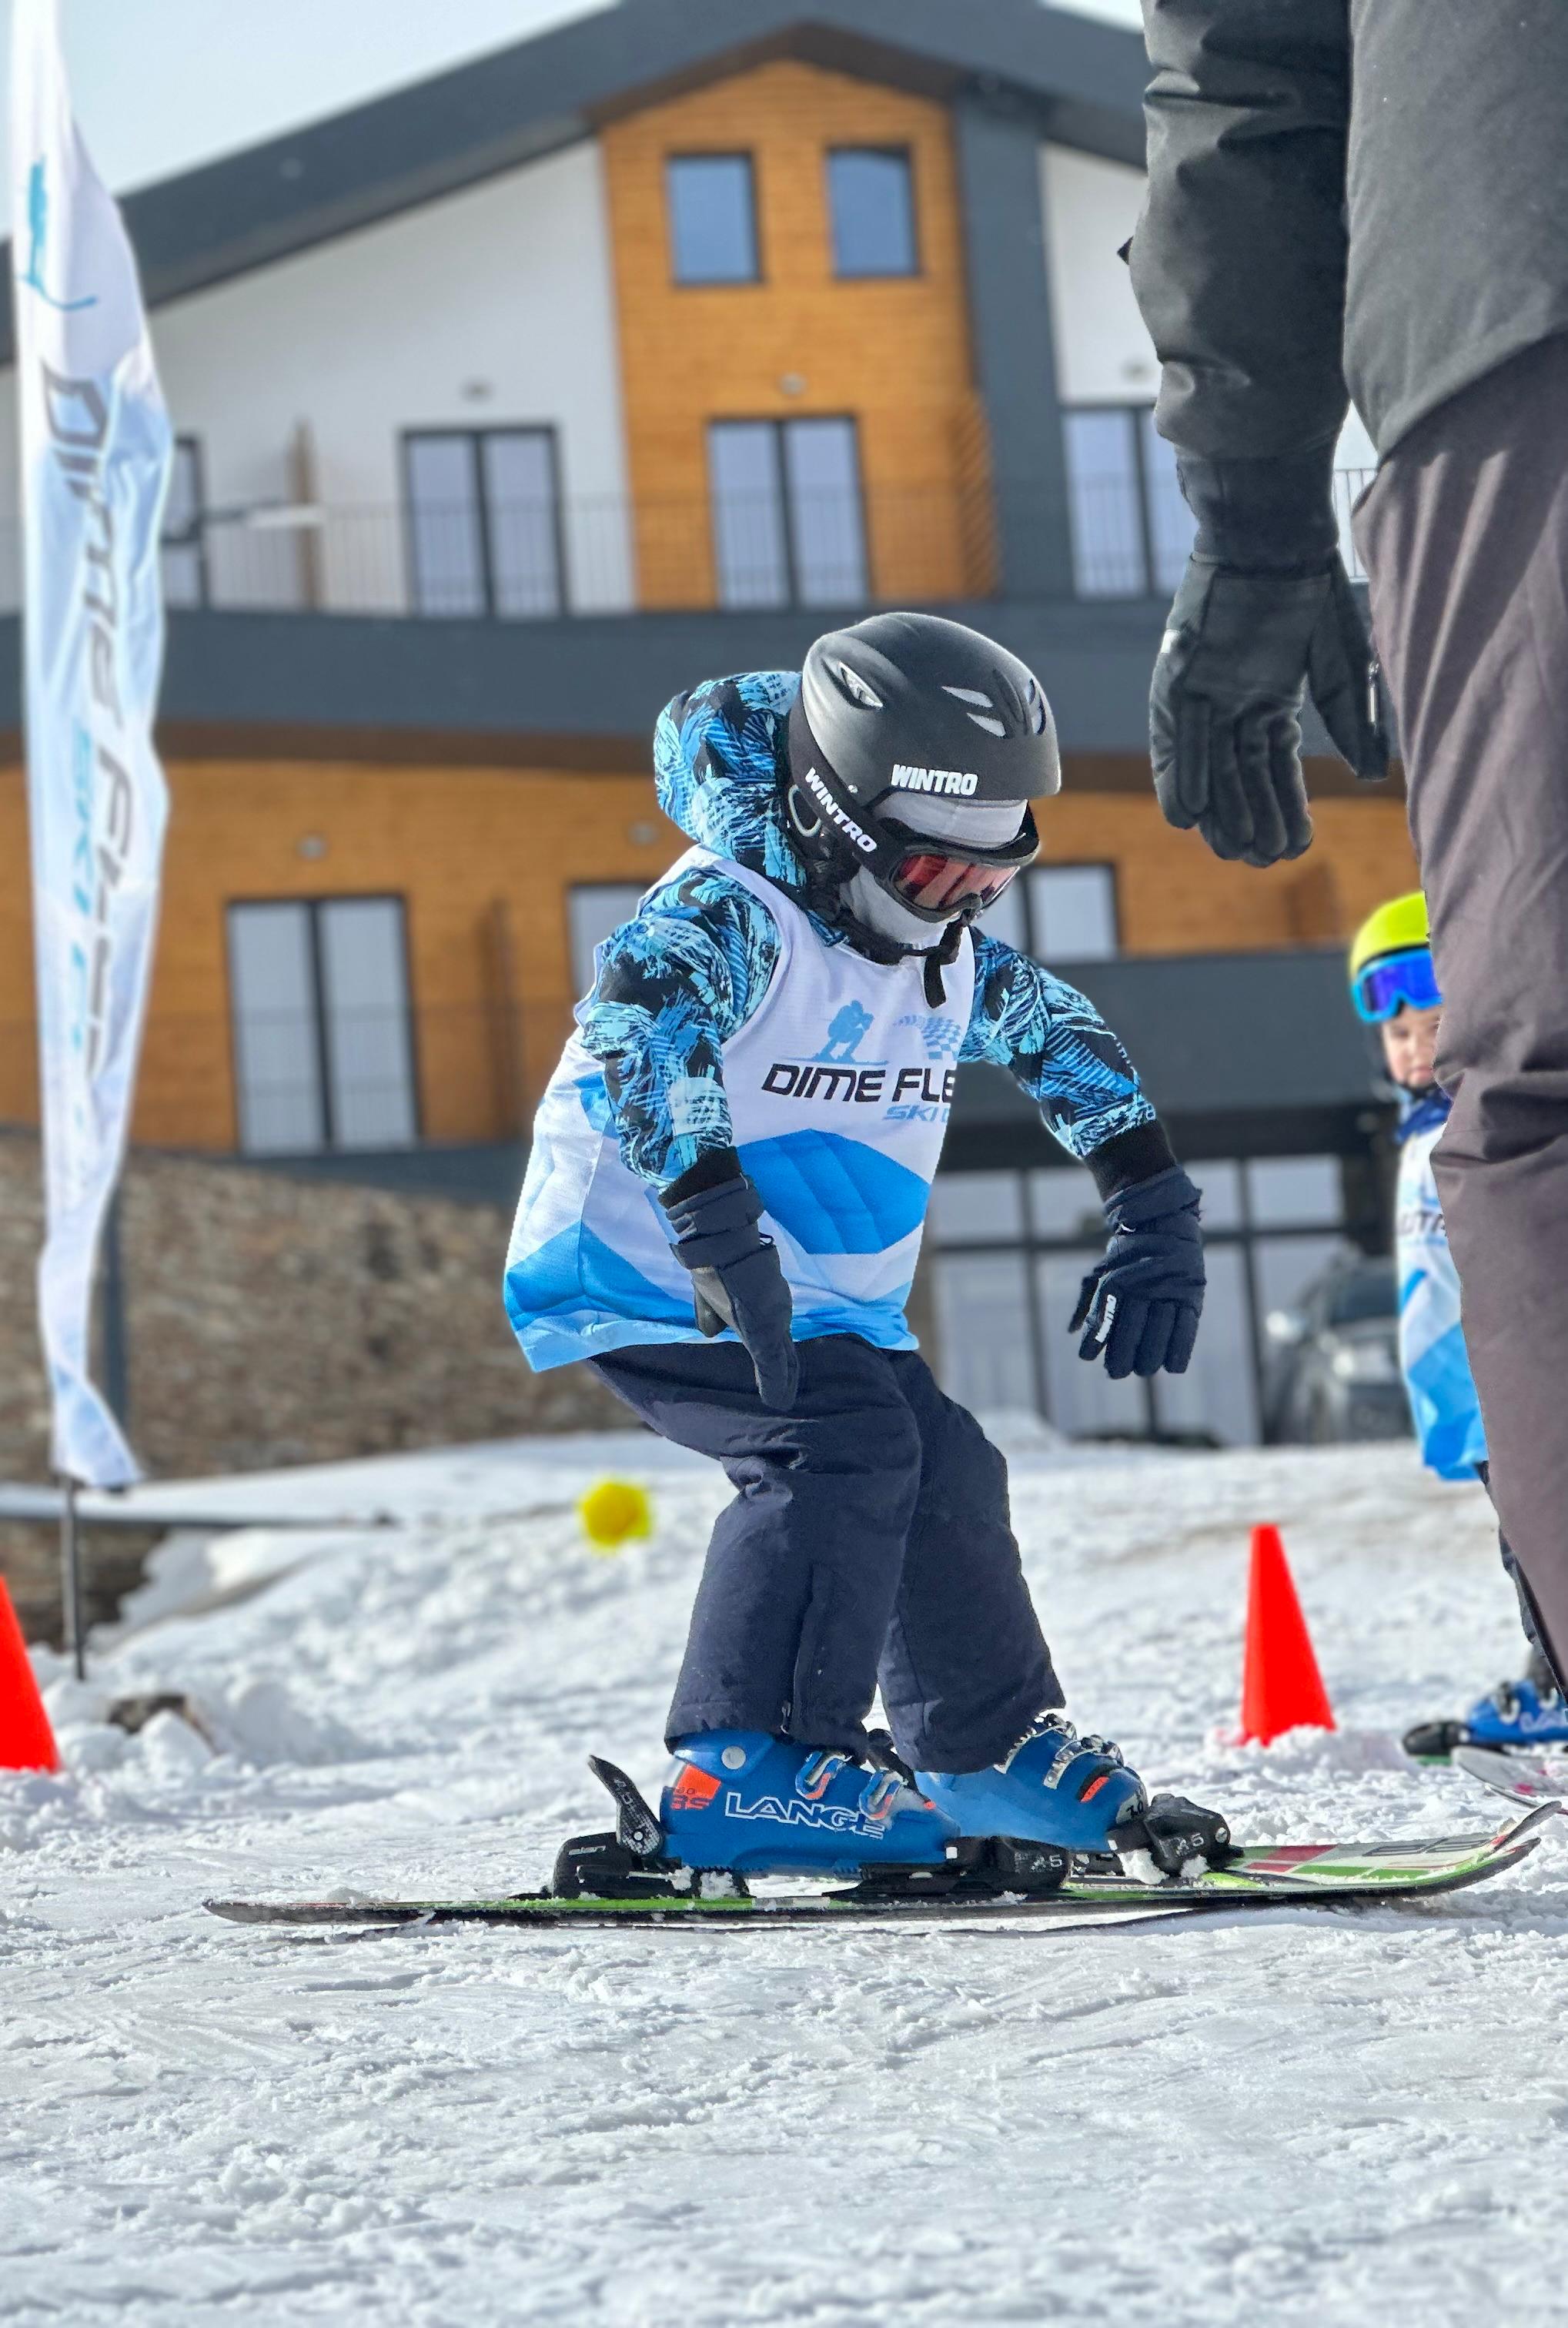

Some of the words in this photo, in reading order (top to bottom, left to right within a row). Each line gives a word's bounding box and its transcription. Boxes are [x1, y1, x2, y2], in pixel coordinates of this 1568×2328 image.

[891, 764, 978, 796] WINTRO
[805, 767, 878, 852] WINTRO
[761, 1063, 887, 1102] DIME
[725, 1791, 886, 1841] LANGE
